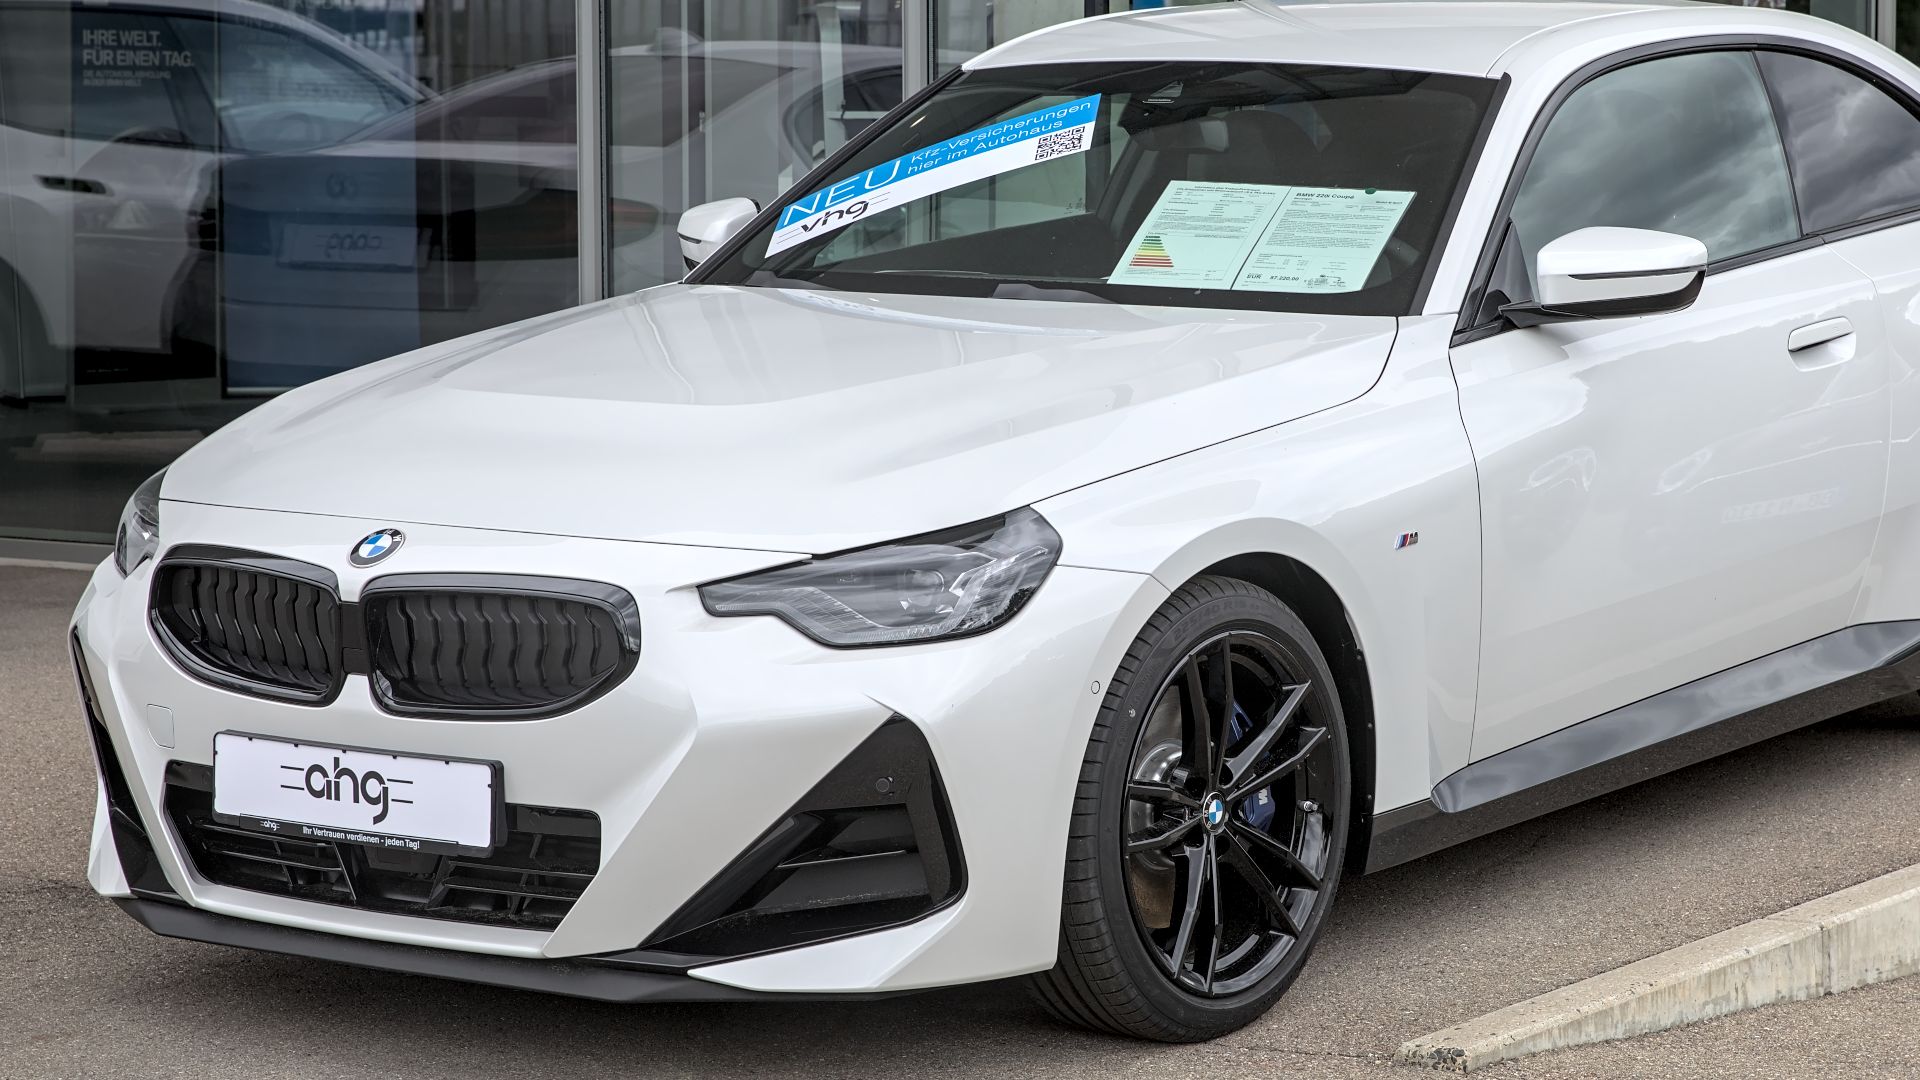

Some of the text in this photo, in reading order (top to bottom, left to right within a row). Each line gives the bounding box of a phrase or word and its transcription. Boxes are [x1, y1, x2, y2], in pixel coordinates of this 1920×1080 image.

[82, 29, 162, 47] IHRE WELT.
[82, 46, 195, 67] FÜR EINEN TAG.
[907, 120, 1064, 175] hier im Autohaus
[910, 101, 1092, 164] Kfz-Versicherungen
[783, 160, 901, 227] NEU
[305, 756, 389, 825] ahg
[303, 826, 312, 835] Ihr
[313, 827, 345, 839] Vertrauen
[346, 833, 379, 844] verdienen
[385, 837, 404, 847] jeden
[405, 840, 420, 850] Tag!
